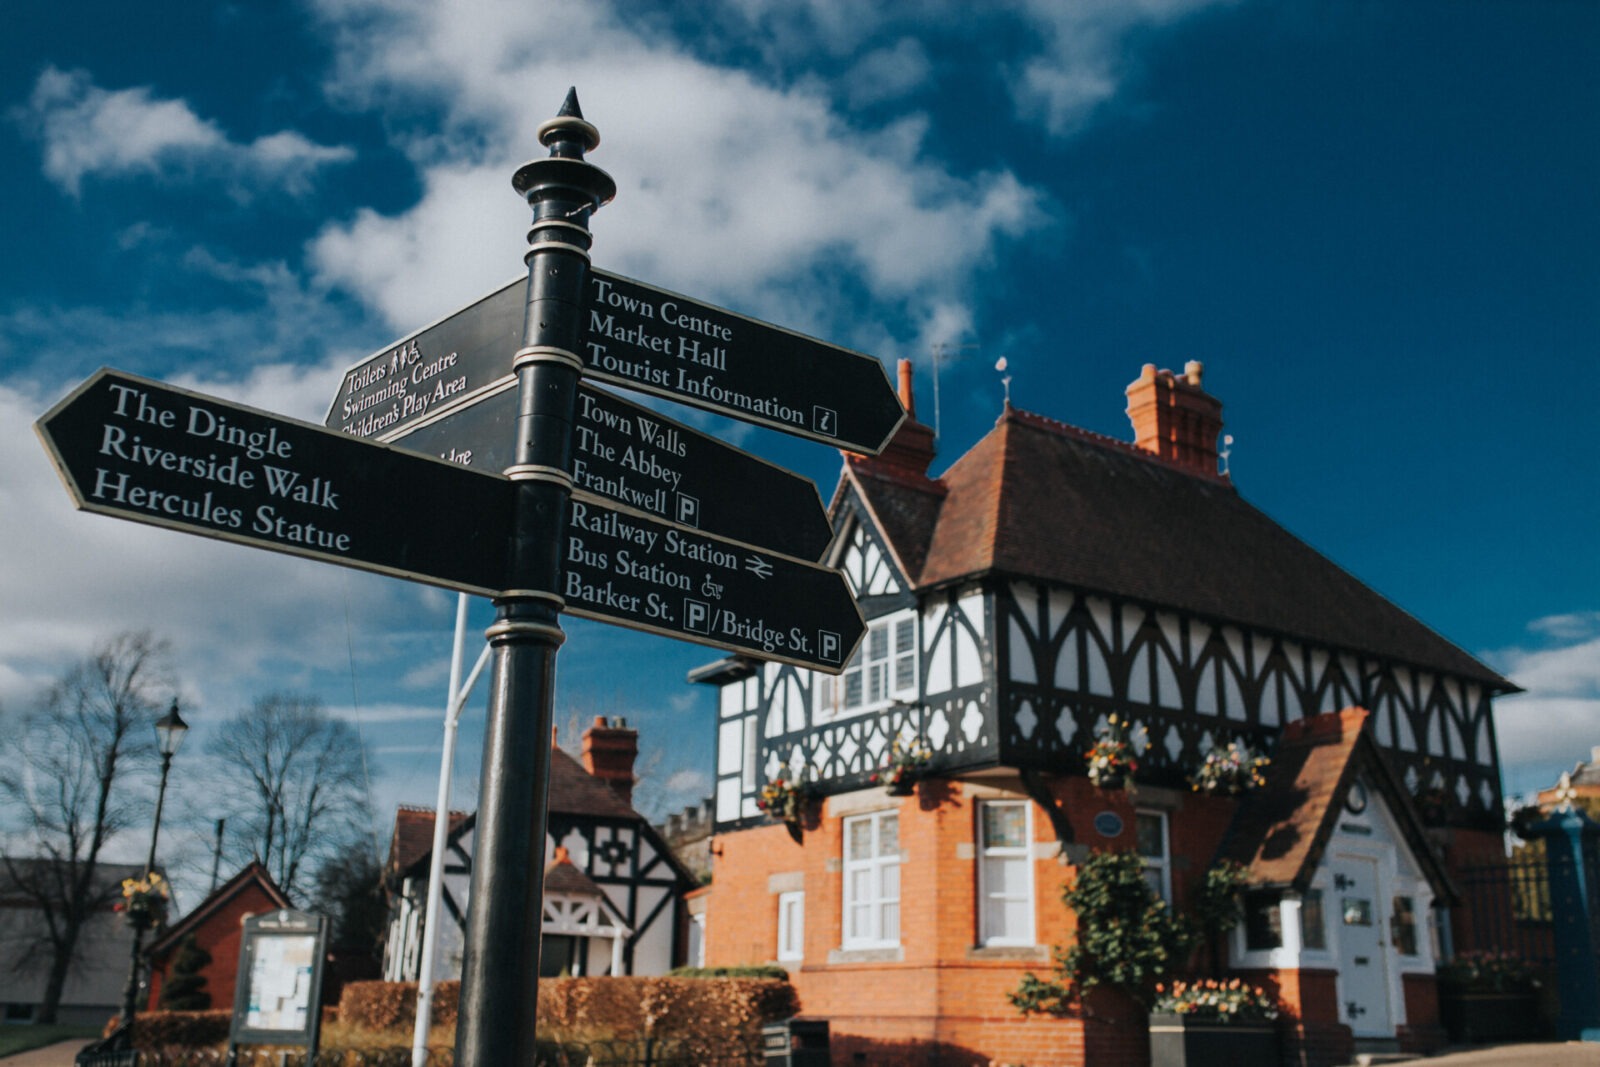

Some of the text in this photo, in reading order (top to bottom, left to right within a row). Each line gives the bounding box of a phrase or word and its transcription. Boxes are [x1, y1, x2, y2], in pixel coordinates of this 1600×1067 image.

[589, 310, 727, 371] Market Hall
[592, 278, 733, 342] Town Centre
[342, 352, 457, 420] Swimming Centre
[348, 363, 386, 395] Toilets
[401, 391, 431, 417] Play
[432, 375, 466, 404] Area
[586, 342, 670, 387] Tourist
[676, 367, 805, 425] Information
[109, 383, 292, 460] The Dingle
[578, 392, 687, 458] Town Walls
[99, 424, 341, 510] Riverside Walk
[573, 458, 666, 515] Frankwell
[576, 425, 682, 492] The Abbey
[92, 467, 350, 551] Hercules Statue
[570, 502, 738, 570] Railway Station
[567, 536, 692, 591] Bus Station
[565, 571, 640, 613] Barker
[645, 592, 674, 622] St.
[789, 627, 813, 655] St.
